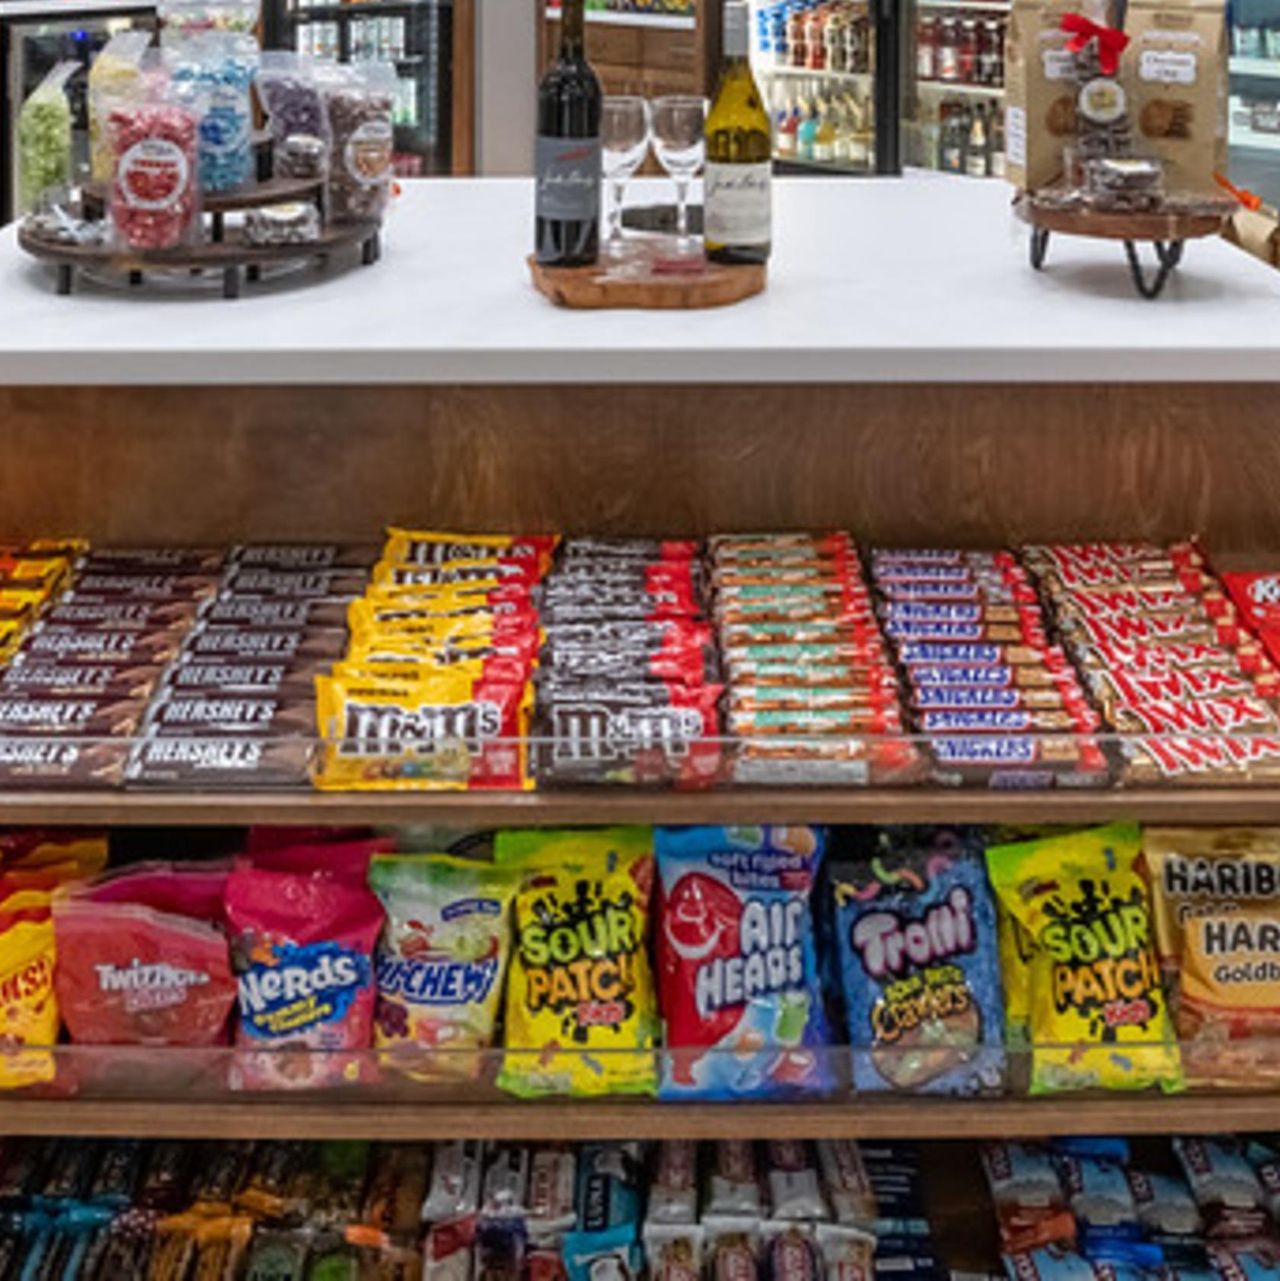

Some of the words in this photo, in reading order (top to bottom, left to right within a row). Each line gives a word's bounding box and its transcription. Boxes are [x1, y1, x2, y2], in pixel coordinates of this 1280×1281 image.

[164, 701, 277, 722] HERSHEY'S
[147, 739, 266, 763] HERSHEY'S
[521, 909, 635, 967] SOUR
[740, 900, 803, 956] AIR
[852, 888, 972, 977] Trolli
[1043, 904, 1148, 963] SOUR
[239, 956, 360, 1016] Nerds
[695, 946, 803, 1021] HEADS
[1055, 952, 1160, 1008] PATCH
